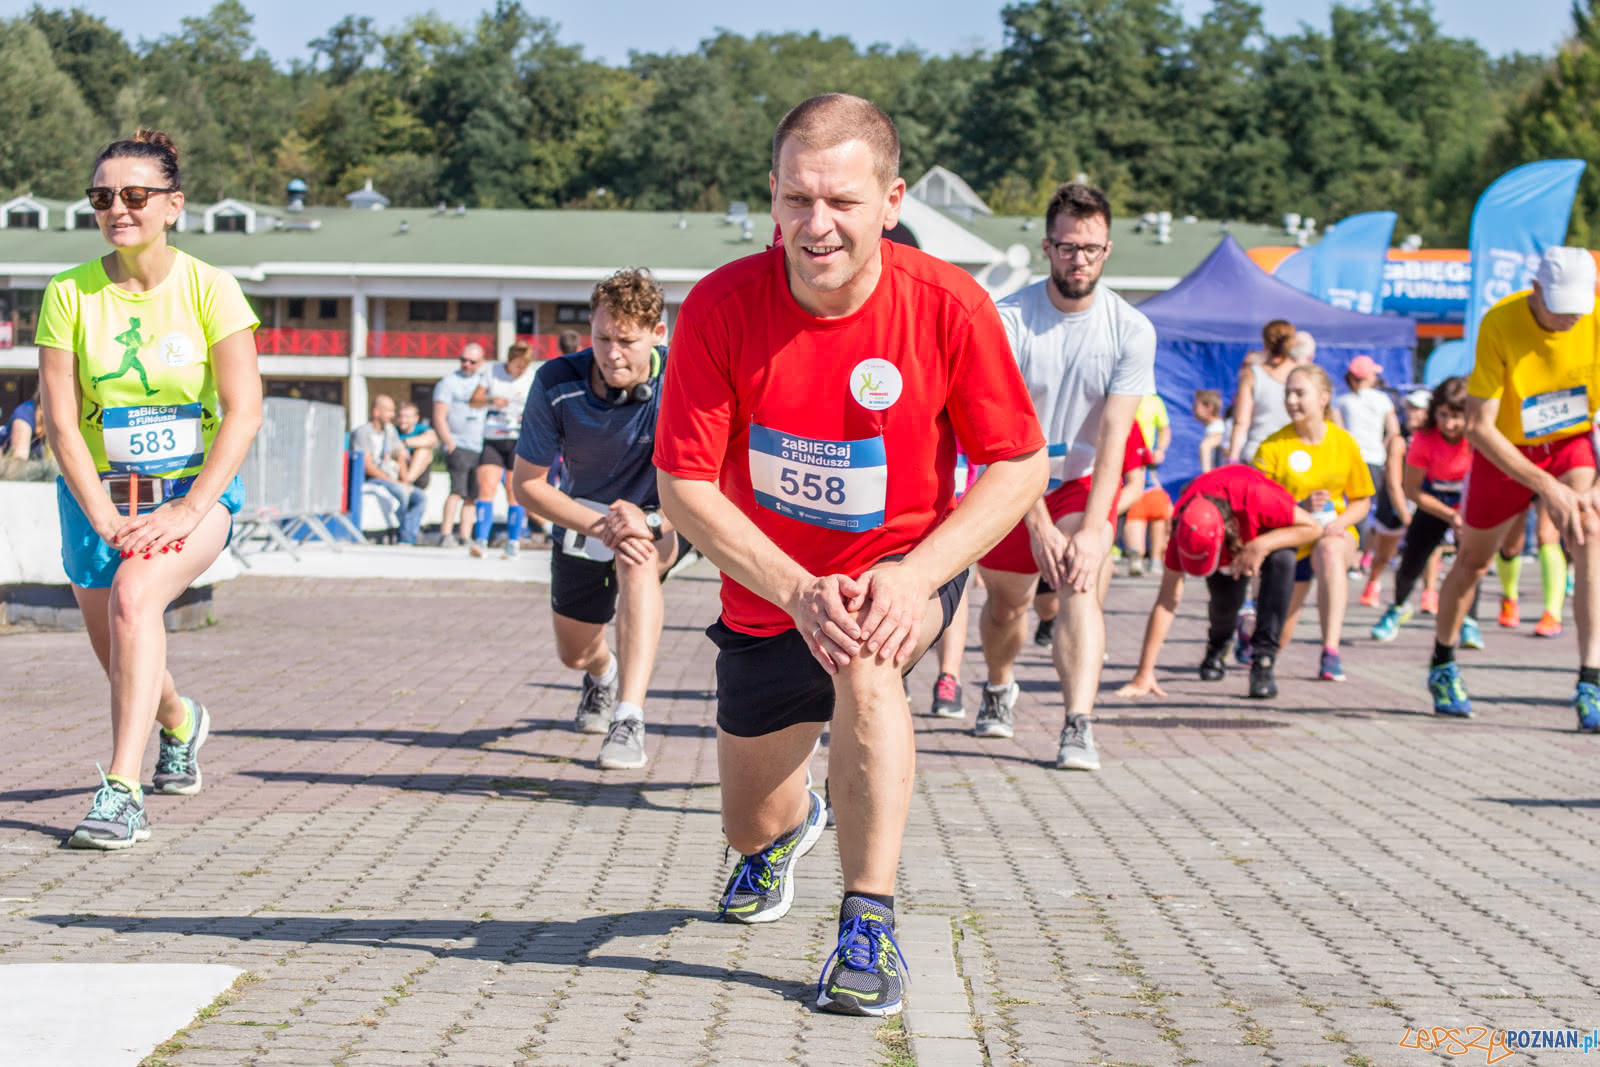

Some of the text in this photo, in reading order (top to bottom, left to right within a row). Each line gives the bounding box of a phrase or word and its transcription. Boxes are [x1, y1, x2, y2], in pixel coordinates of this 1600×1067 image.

[128, 406, 177, 418] zaBIEGaj
[1538, 402, 1569, 423] 534
[129, 428, 176, 456] 583
[781, 437, 851, 460] zaBIEGaj
[781, 450, 851, 467] o FUNdusze
[780, 467, 846, 505] 558
